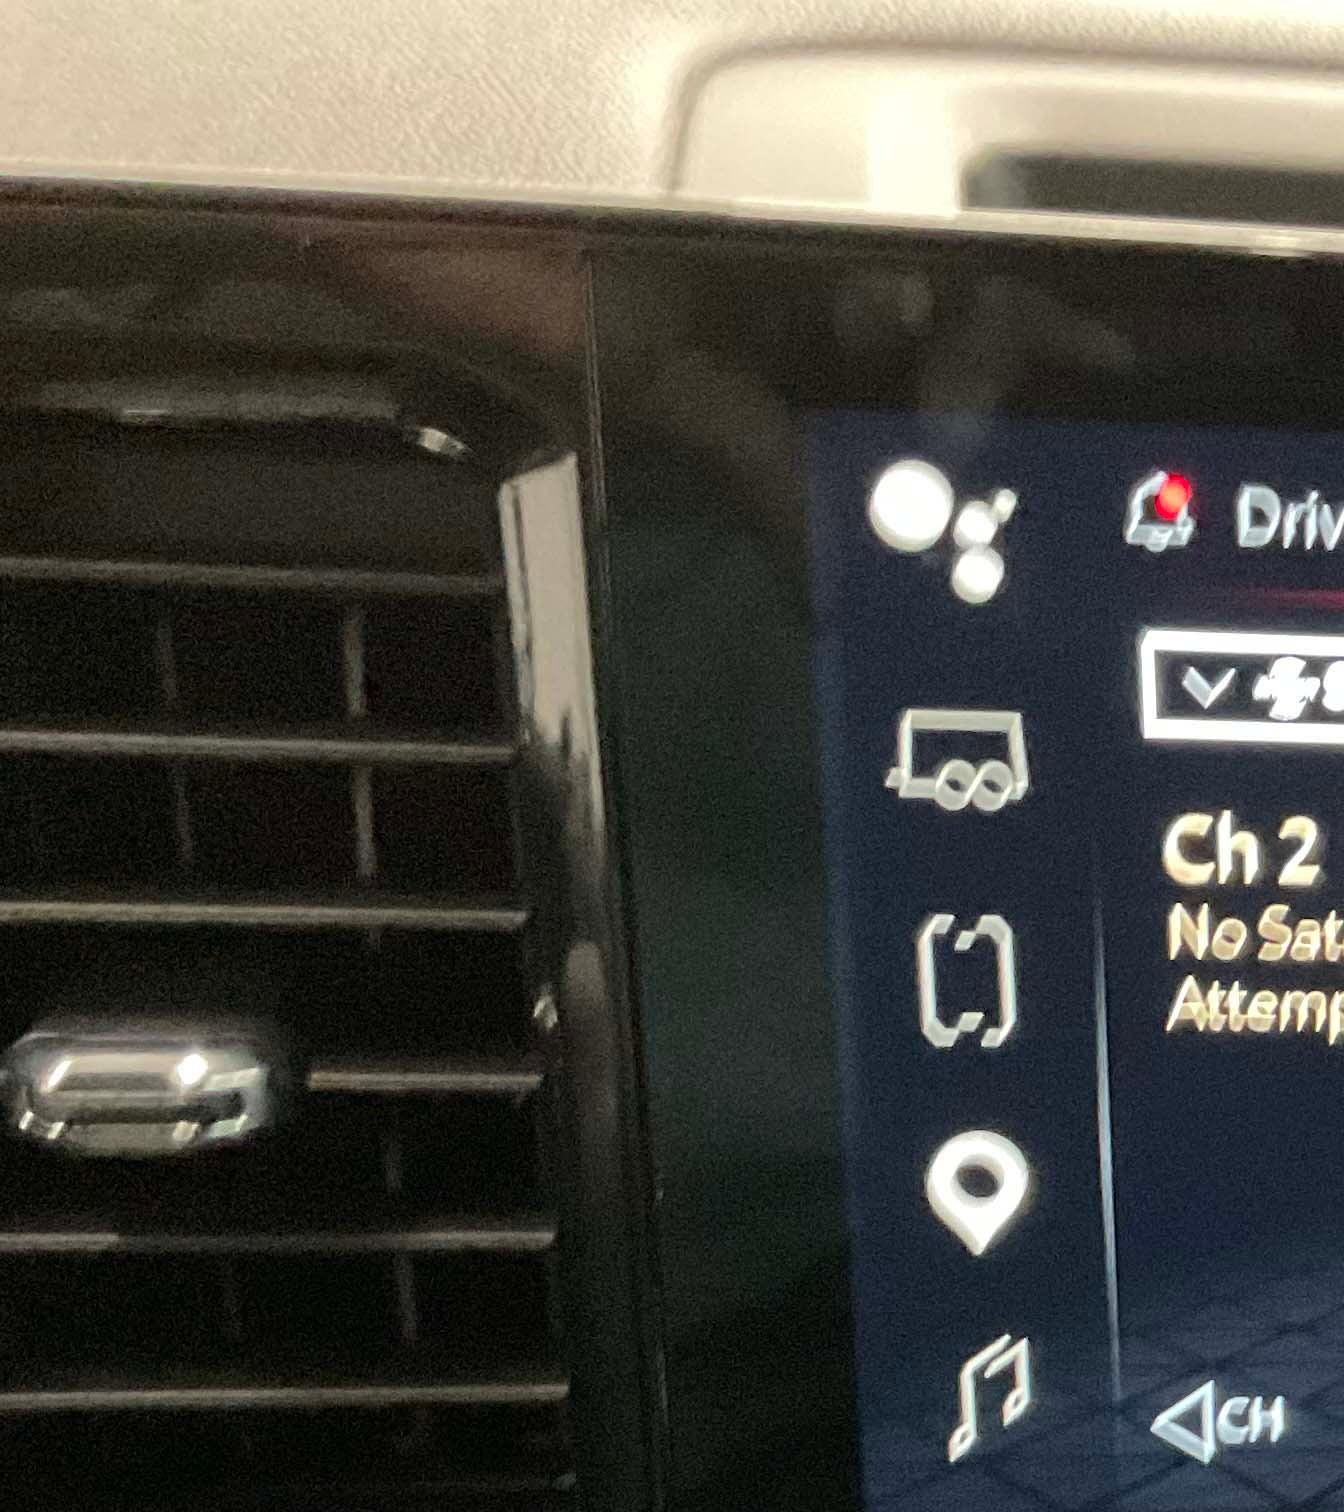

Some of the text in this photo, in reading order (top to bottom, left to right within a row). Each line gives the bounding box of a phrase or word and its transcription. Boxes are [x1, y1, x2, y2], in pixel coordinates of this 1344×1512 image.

[1163, 810, 1260, 885] Ch
[1278, 816, 1320, 886] 2
[1168, 903, 1247, 960] No
[1218, 1396, 1286, 1444] CH
